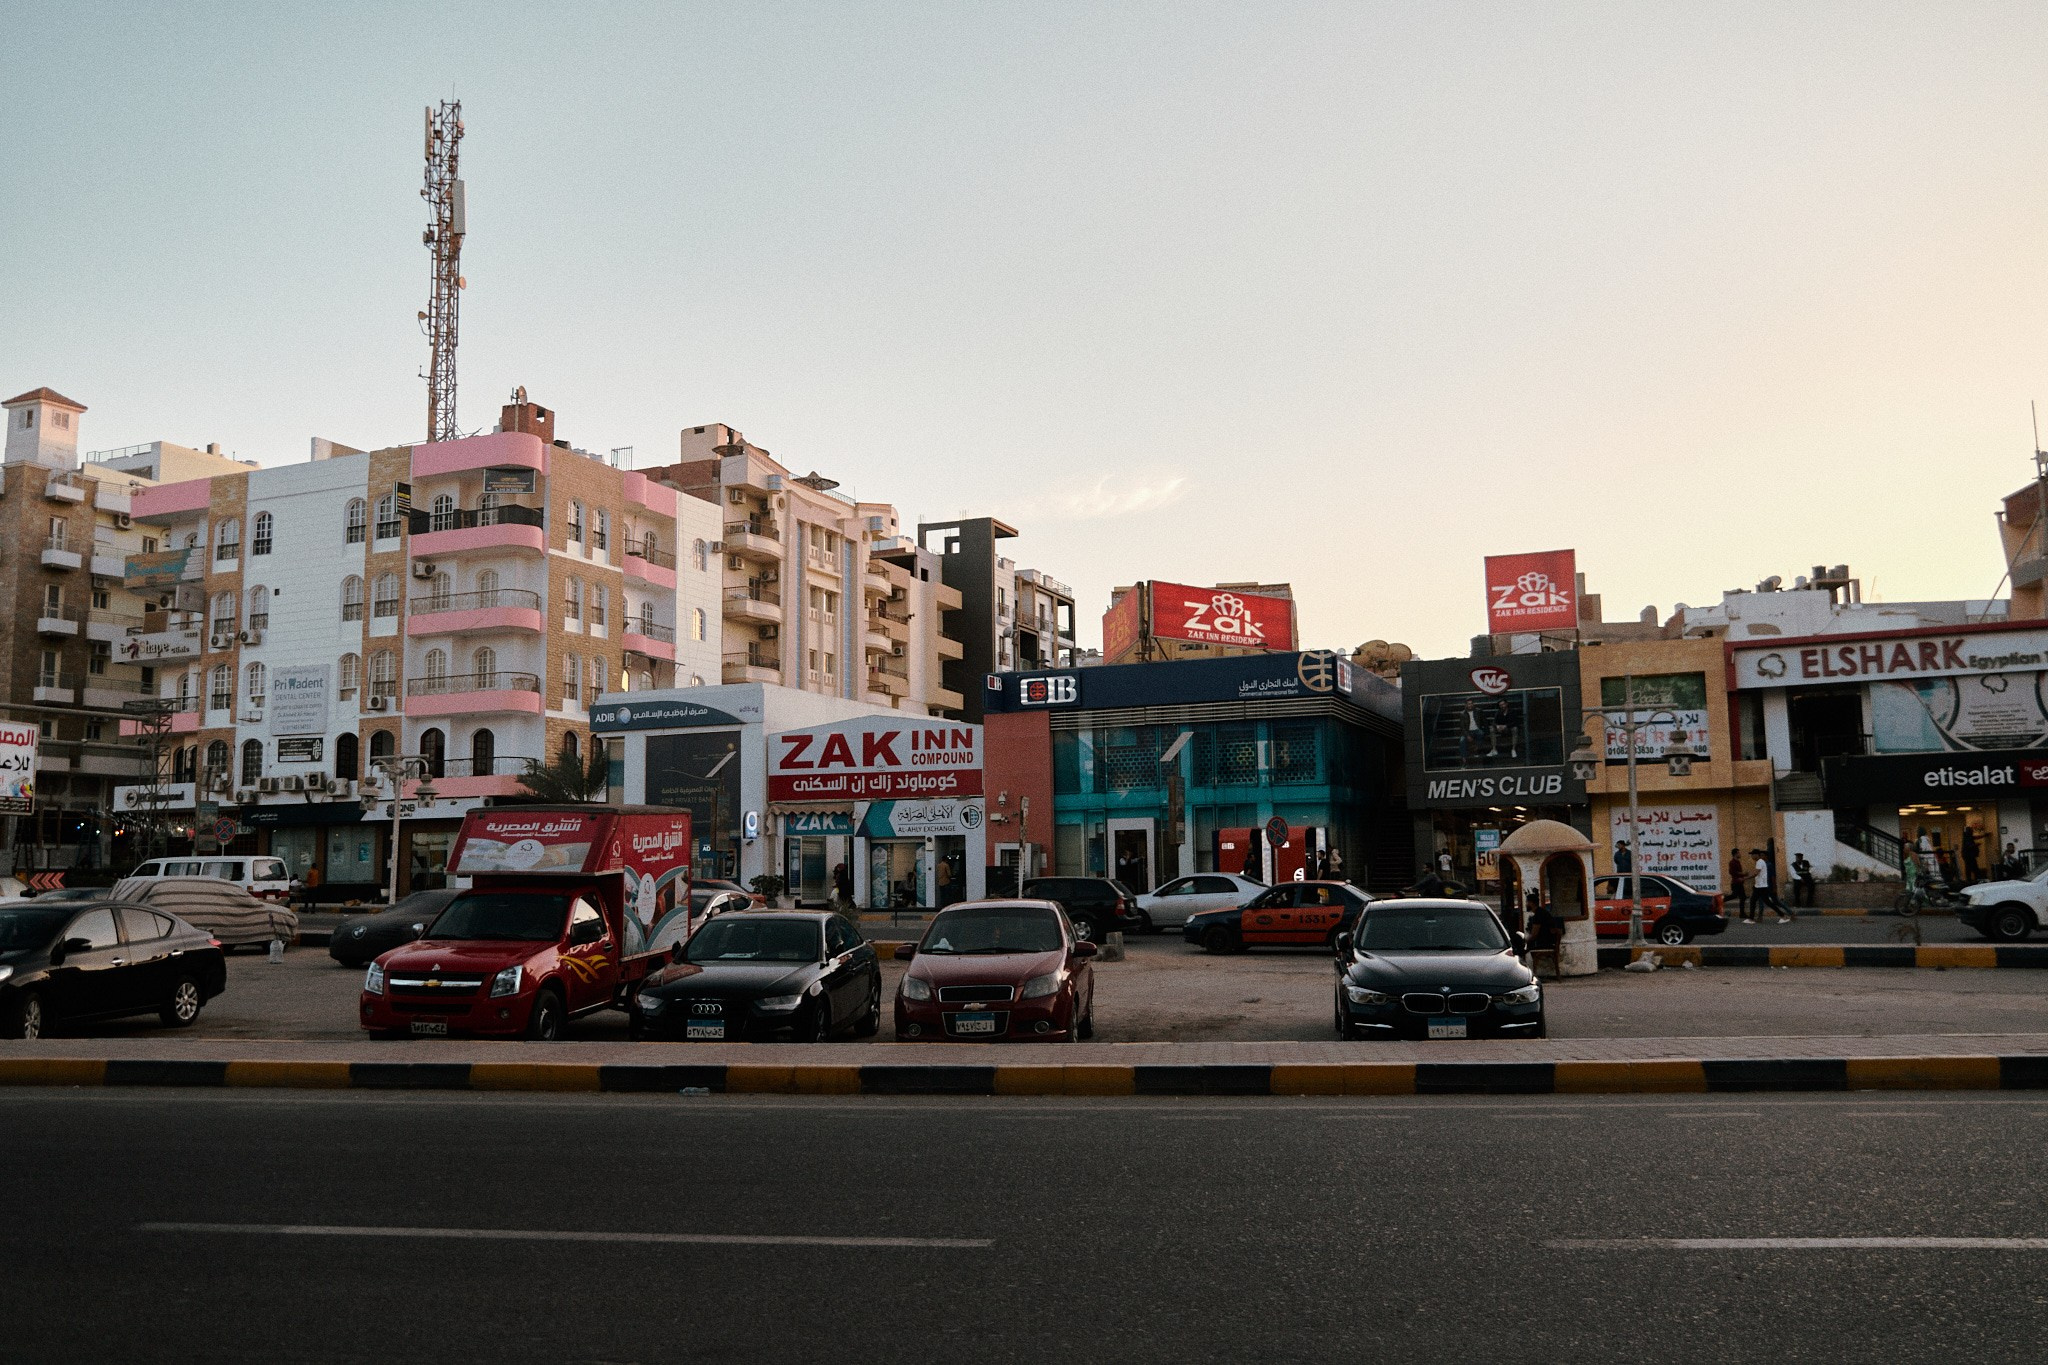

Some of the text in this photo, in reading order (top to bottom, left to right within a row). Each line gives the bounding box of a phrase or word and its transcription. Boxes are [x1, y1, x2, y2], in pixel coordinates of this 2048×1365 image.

[1491, 582, 1571, 609] Zak
[1526, 605, 1567, 615] RESIDENCE
[1183, 601, 1265, 638] Zak
[1188, 630, 1262, 646] ZAK INN RESIDENCE
[1800, 639, 1967, 678] ELSHARK
[1968, 652, 2040, 670] Egyptian
[1282, 677, 1298, 688] البنك
[275, 691, 322, 701] DENTAL CENTER
[595, 712, 615, 722] ADIB
[689, 707, 708, 717] مصرف
[911, 728, 973, 750] INN
[779, 731, 902, 770] ZAK
[911, 751, 974, 765] COMPOUND
[793, 773, 958, 793] كومباوند زاك إن السكنى
[1924, 765, 2015, 787] etisalat
[1427, 774, 1562, 799] MEN'S CLUB
[795, 815, 836, 831] ZAK
[1673, 811, 1712, 824] محل
[486, 821, 581, 832] الشرق المصرية
[1669, 827, 1701, 836] مساحة
[633, 832, 663, 853] المصرية
[1657, 851, 1675, 862] for
[1680, 851, 1712, 860] Rent
[1647, 864, 1678, 872] square
[1681, 863, 1708, 871] meter
